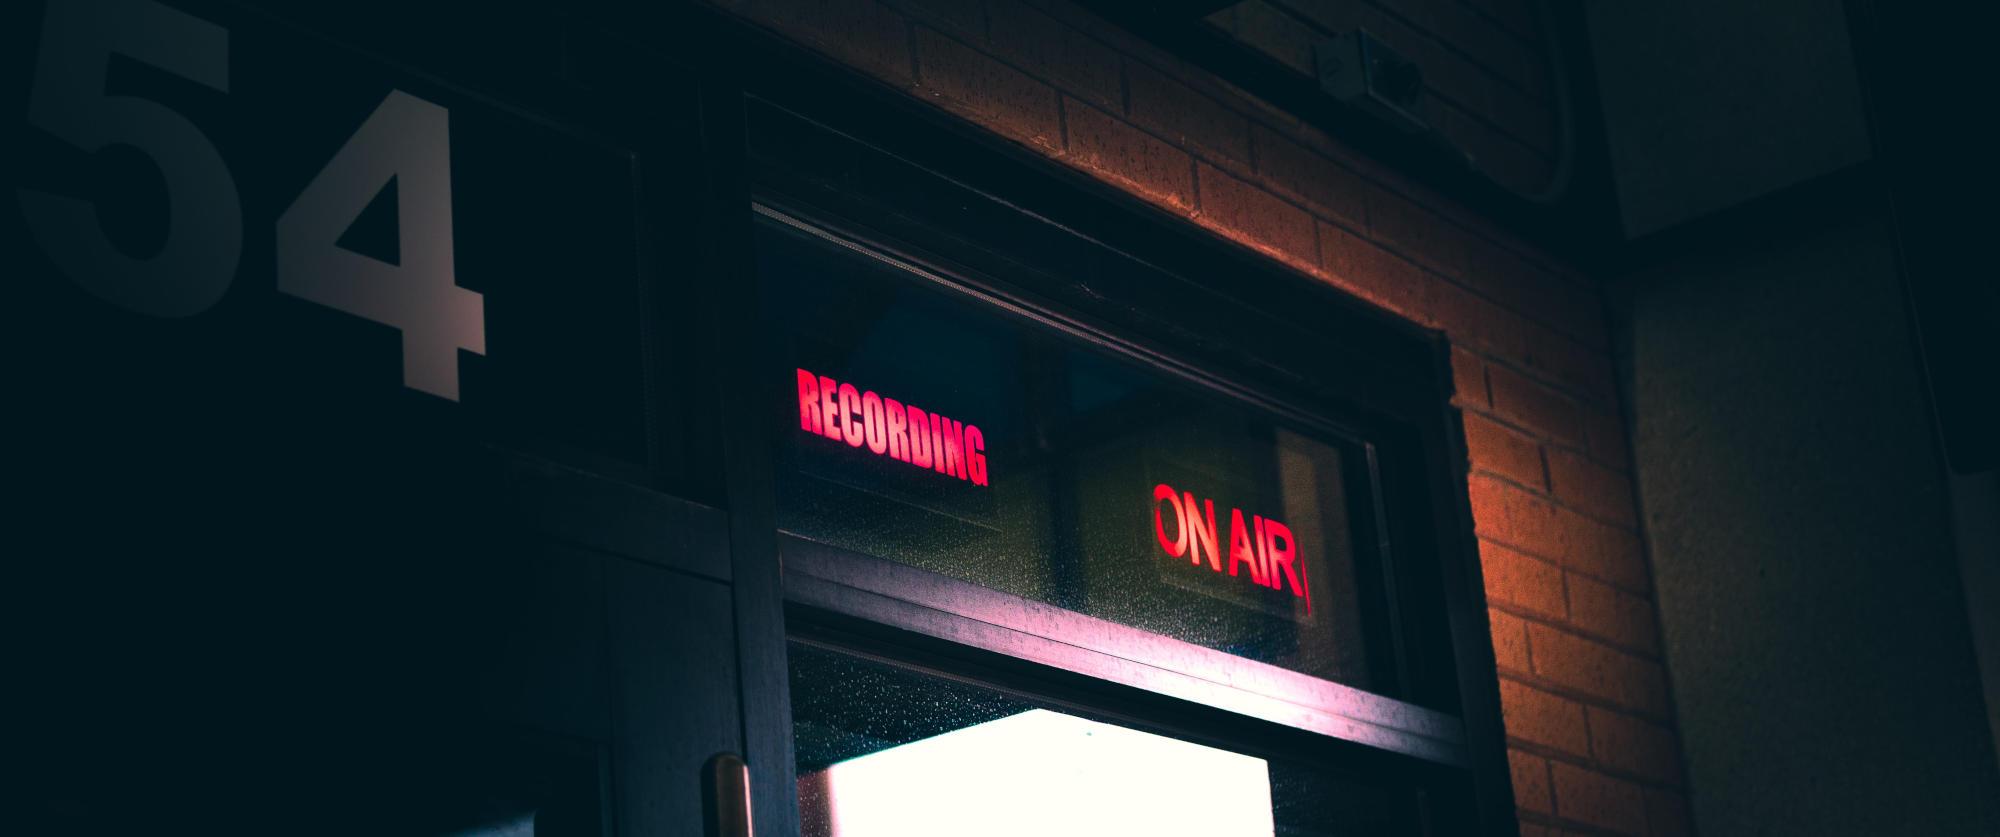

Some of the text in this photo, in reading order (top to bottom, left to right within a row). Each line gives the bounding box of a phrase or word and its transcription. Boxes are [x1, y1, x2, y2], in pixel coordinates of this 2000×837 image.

[16, 0, 487, 403] 54
[797, 368, 989, 487] RECORDING
[1153, 484, 1304, 597] ON AIR
